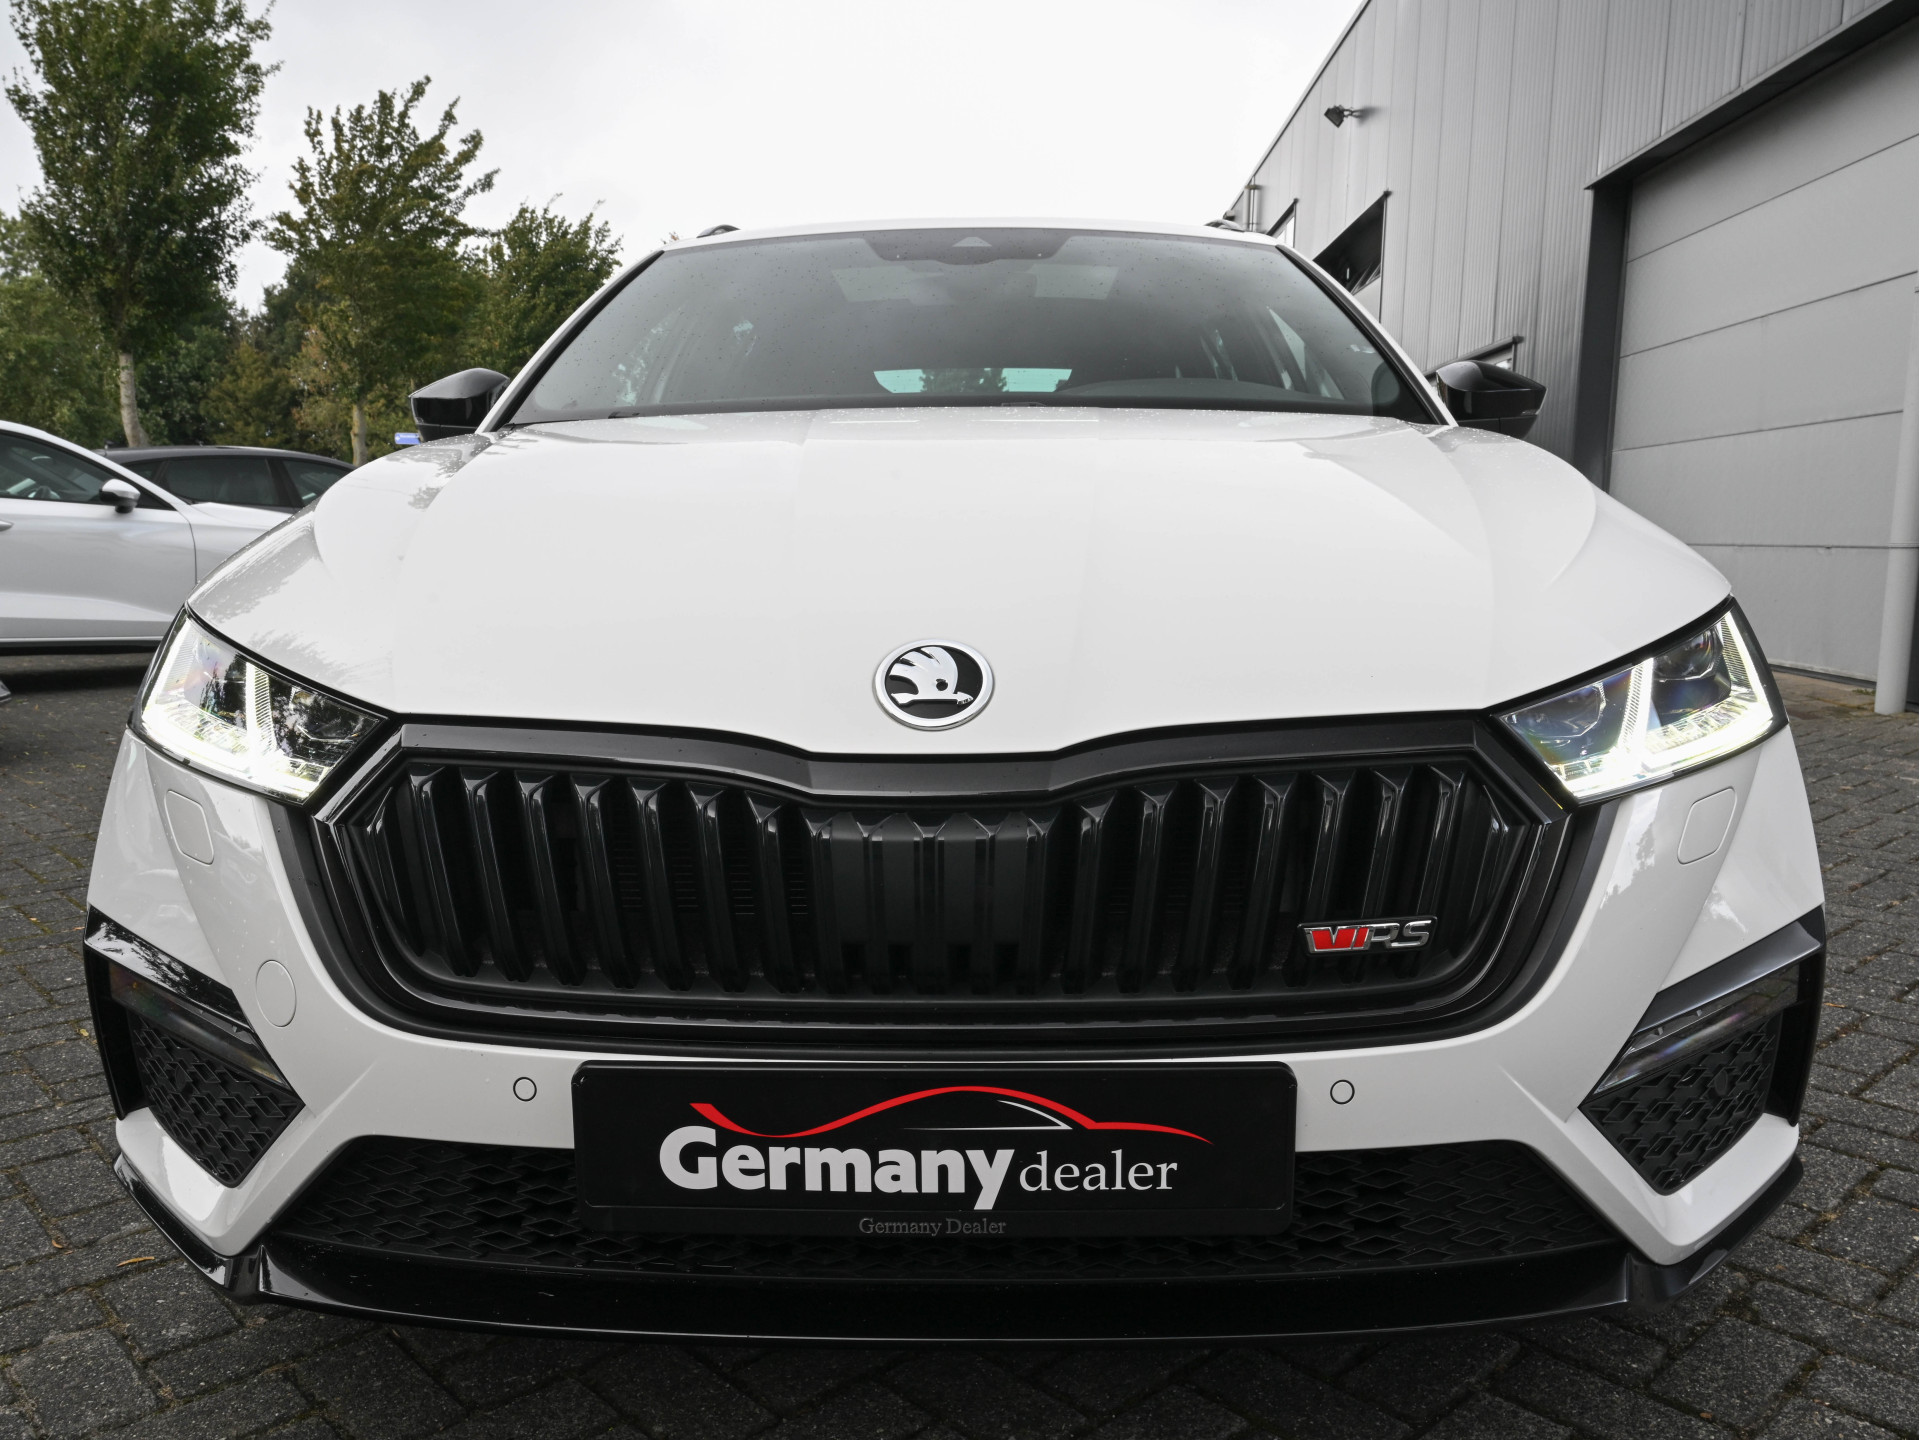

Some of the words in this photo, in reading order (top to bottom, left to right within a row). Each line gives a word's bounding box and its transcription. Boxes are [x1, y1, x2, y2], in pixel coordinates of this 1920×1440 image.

[660, 1125, 1015, 1210] Germany
[1019, 1149, 1178, 1191] dealer
[859, 1217, 942, 1237] Germany
[945, 1217, 1006, 1234] Dealer
